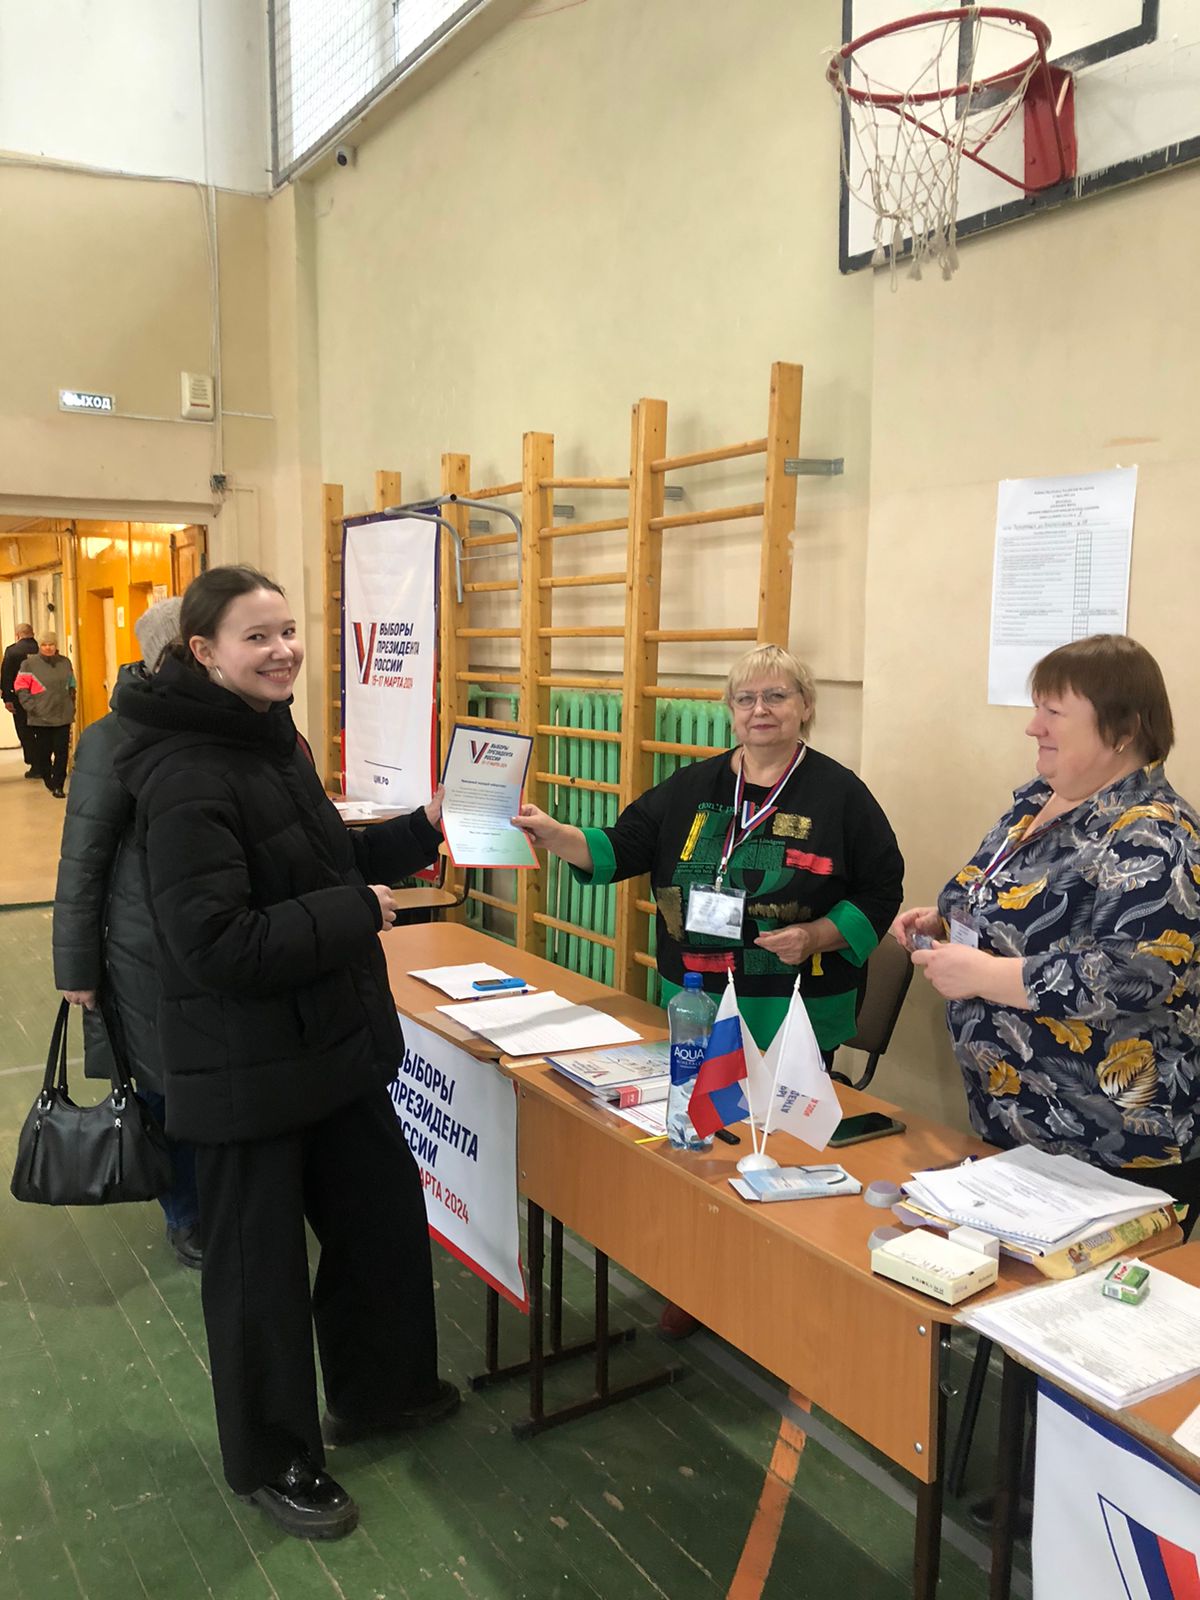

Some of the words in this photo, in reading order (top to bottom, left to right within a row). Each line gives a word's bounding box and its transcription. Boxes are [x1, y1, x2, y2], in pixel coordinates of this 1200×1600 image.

[379, 622, 414, 637] ВЫБОРЫ
[376, 640, 420, 656] ПРЕЗИДЕНТА
[374, 658, 404, 673] РОССИИ
[674, 1045, 705, 1060] AQUA
[390, 1078, 479, 1162] ПРЕЗИДЕНТА
[396, 1115, 439, 1168] ССИИ
[444, 1187, 469, 1225] 2024
